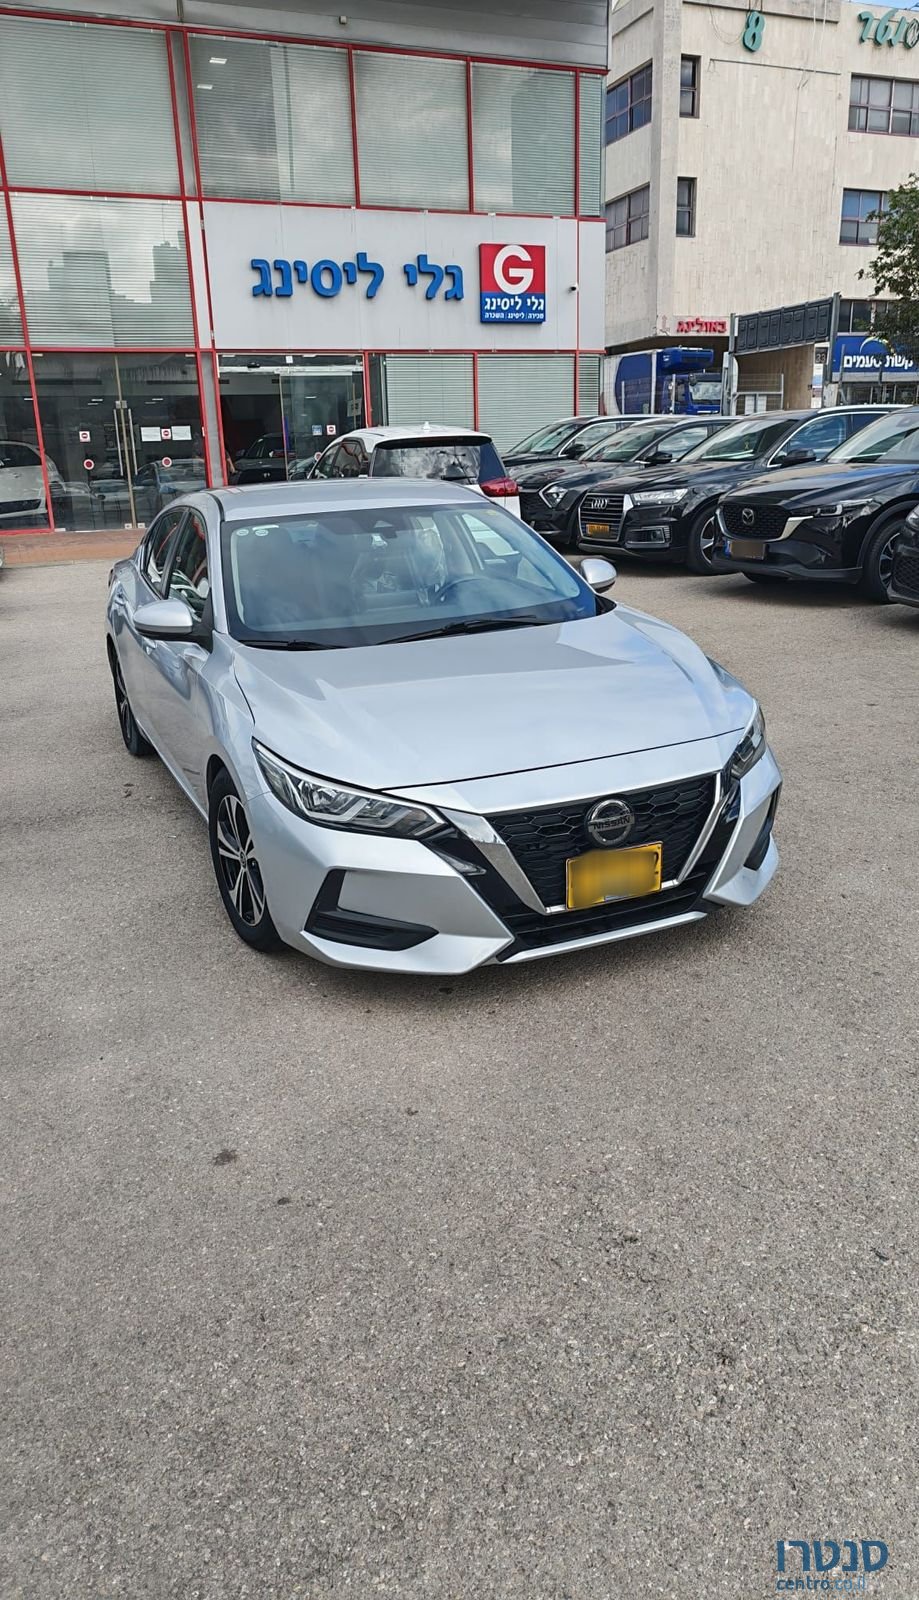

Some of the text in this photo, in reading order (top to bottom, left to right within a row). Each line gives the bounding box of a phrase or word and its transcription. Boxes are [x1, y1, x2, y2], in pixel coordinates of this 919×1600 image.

[743, 10, 765, 53] 8
[250, 252, 464, 301] גלי ליסינג
[494, 244, 534, 295] G
[484, 295, 544, 311] גלי ליסינג
[592, 815, 631, 830] NISSAN
